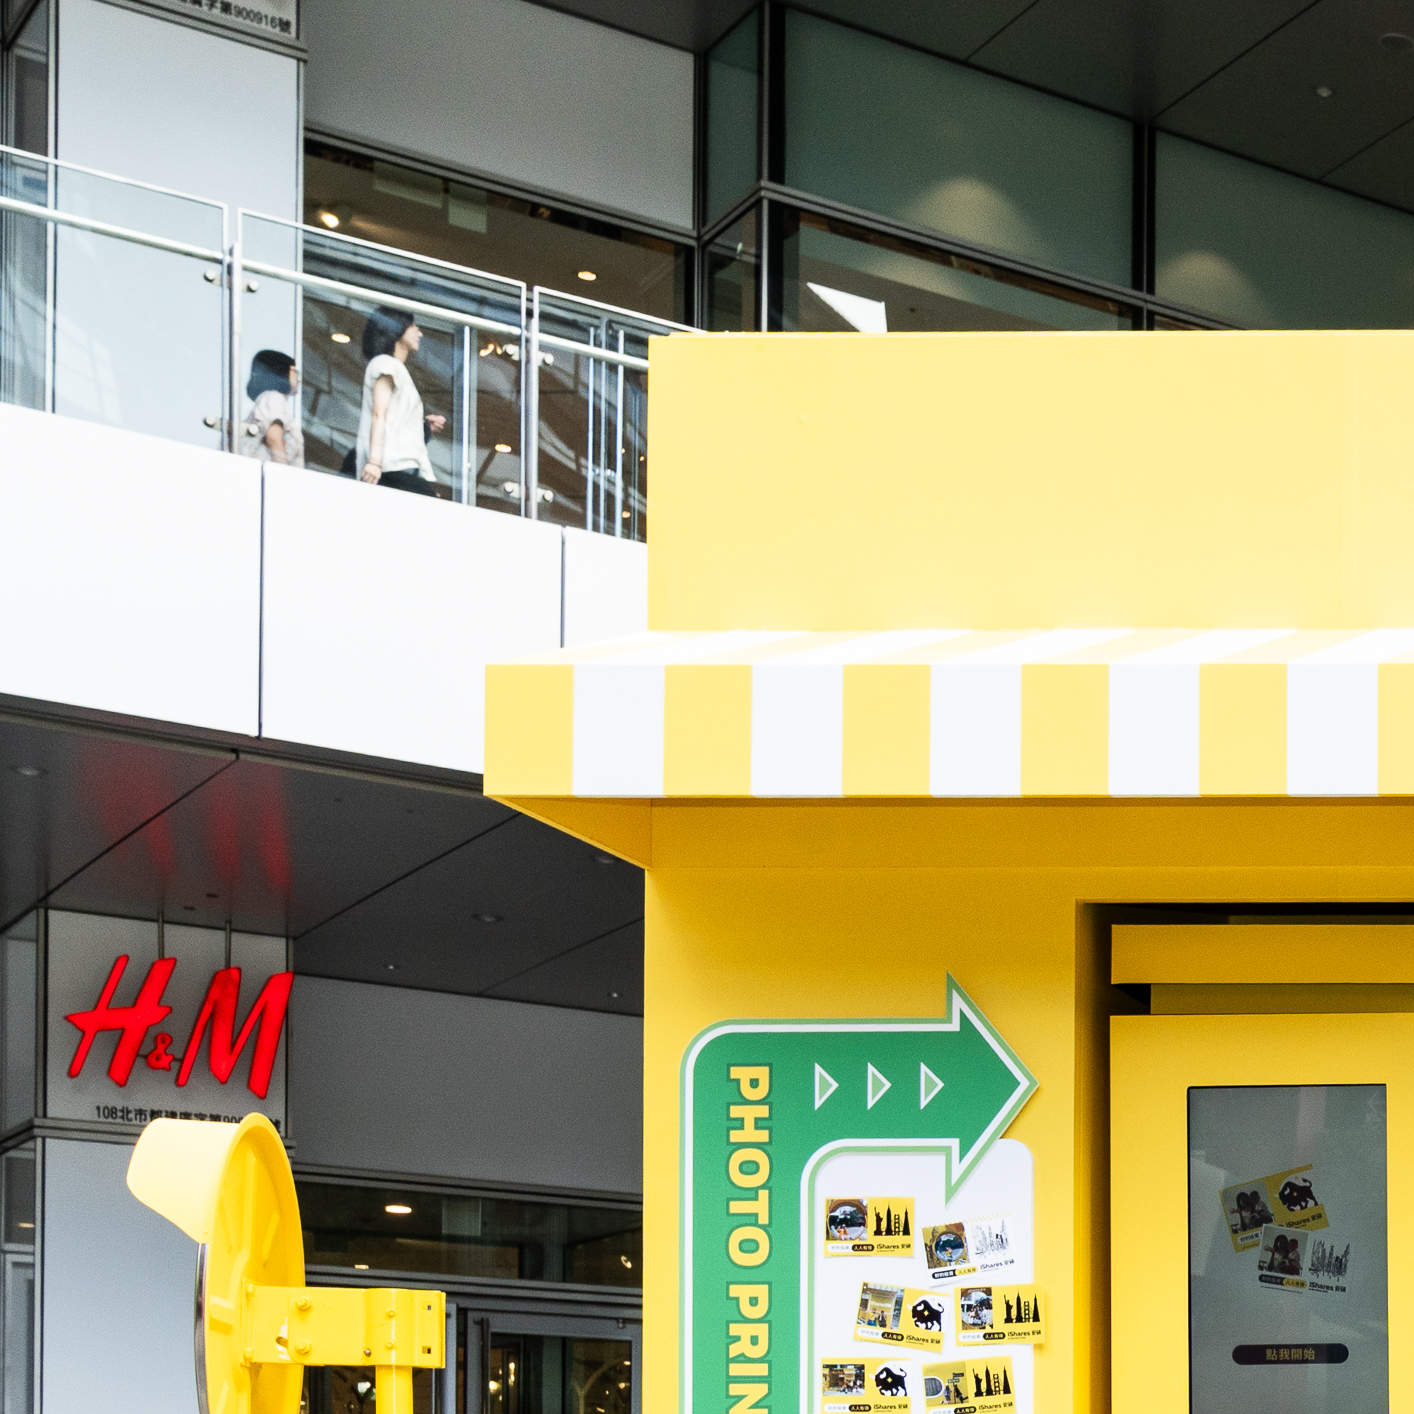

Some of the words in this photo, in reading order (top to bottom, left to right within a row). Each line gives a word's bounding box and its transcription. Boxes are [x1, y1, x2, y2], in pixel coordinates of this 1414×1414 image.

[65, 954, 293, 1100] H&M
[728, 1064, 773, 1268] PHOTO
[1285, 1217, 1311, 1229] iShares
[876, 1239, 899, 1250] iShares
[980, 1262, 1003, 1270] iShares
[1308, 1281, 1334, 1292] iShares
[906, 1334, 929, 1344] iShares
[1007, 1330, 1031, 1338] iShares
[1265, 1348, 1316, 1361] 點我開始
[873, 1403, 897, 1411] iShares
[978, 1403, 1002, 1412] iShares
